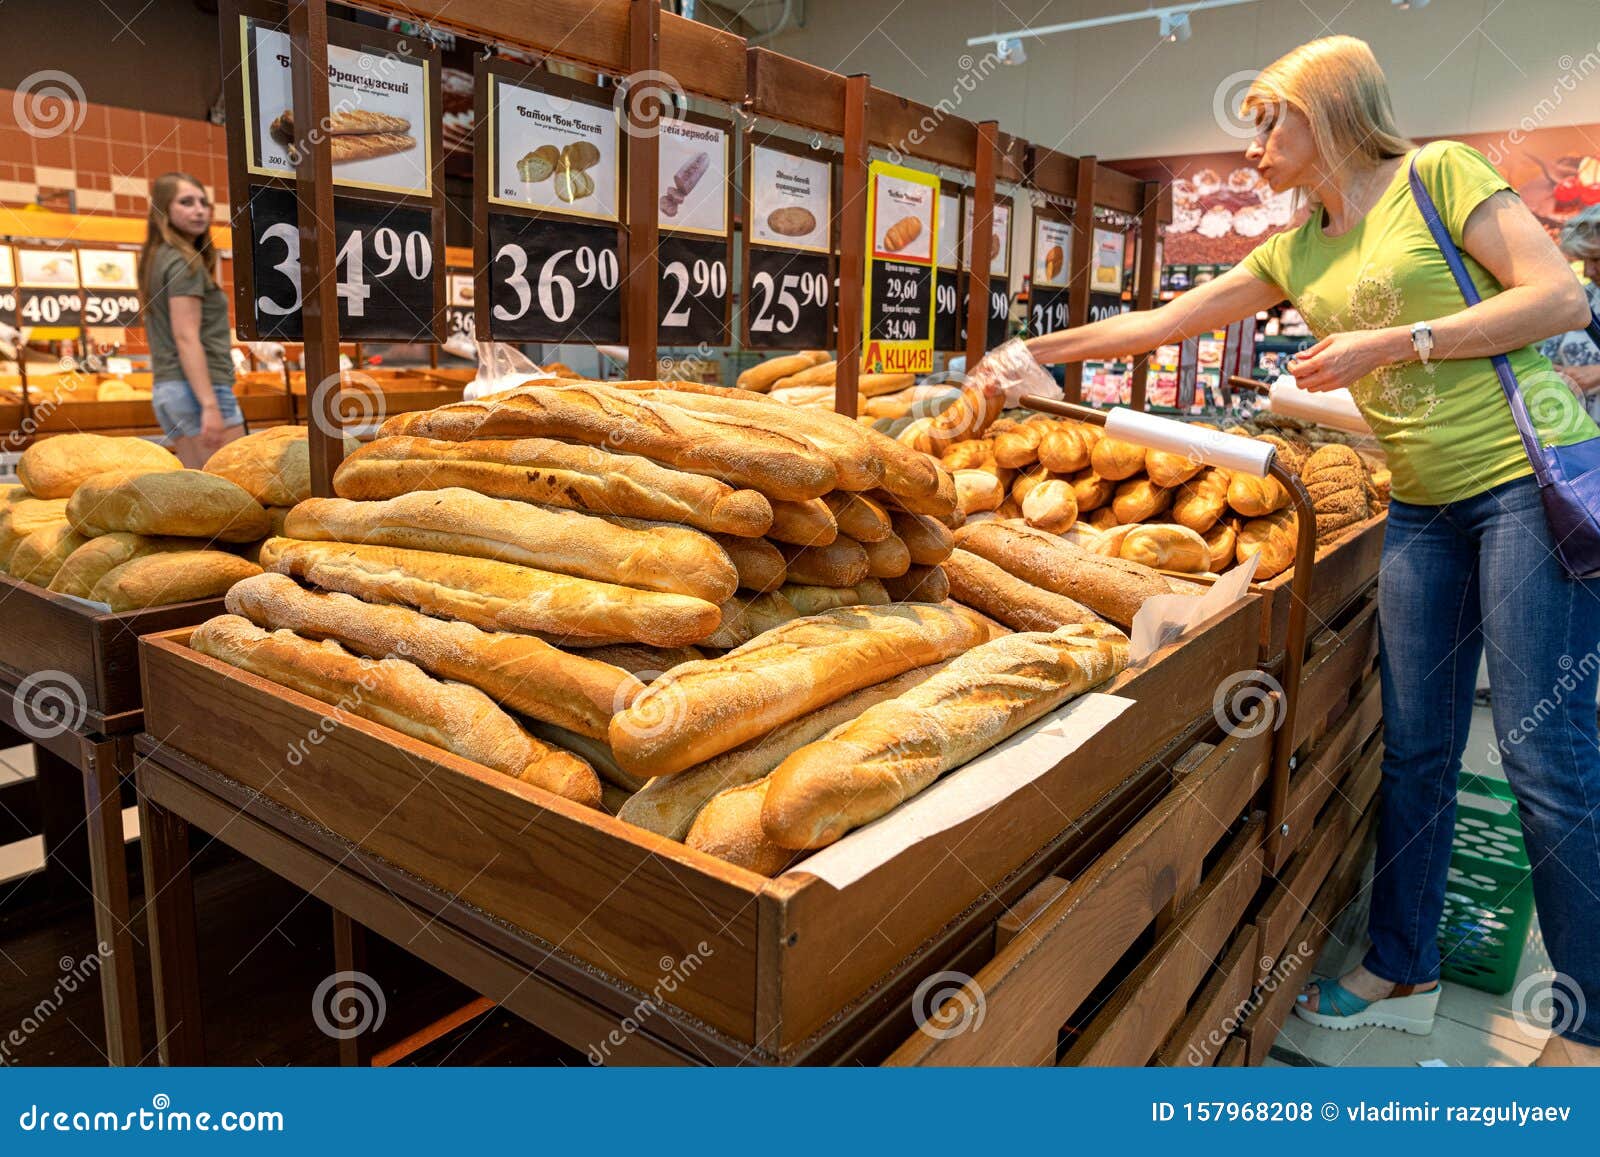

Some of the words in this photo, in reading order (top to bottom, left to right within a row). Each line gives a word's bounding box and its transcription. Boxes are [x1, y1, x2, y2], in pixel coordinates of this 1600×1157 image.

[517, 105, 551, 123] Батон
[552, 114, 602, 135] Бон-Багет
[886, 278, 918, 303] 29,60
